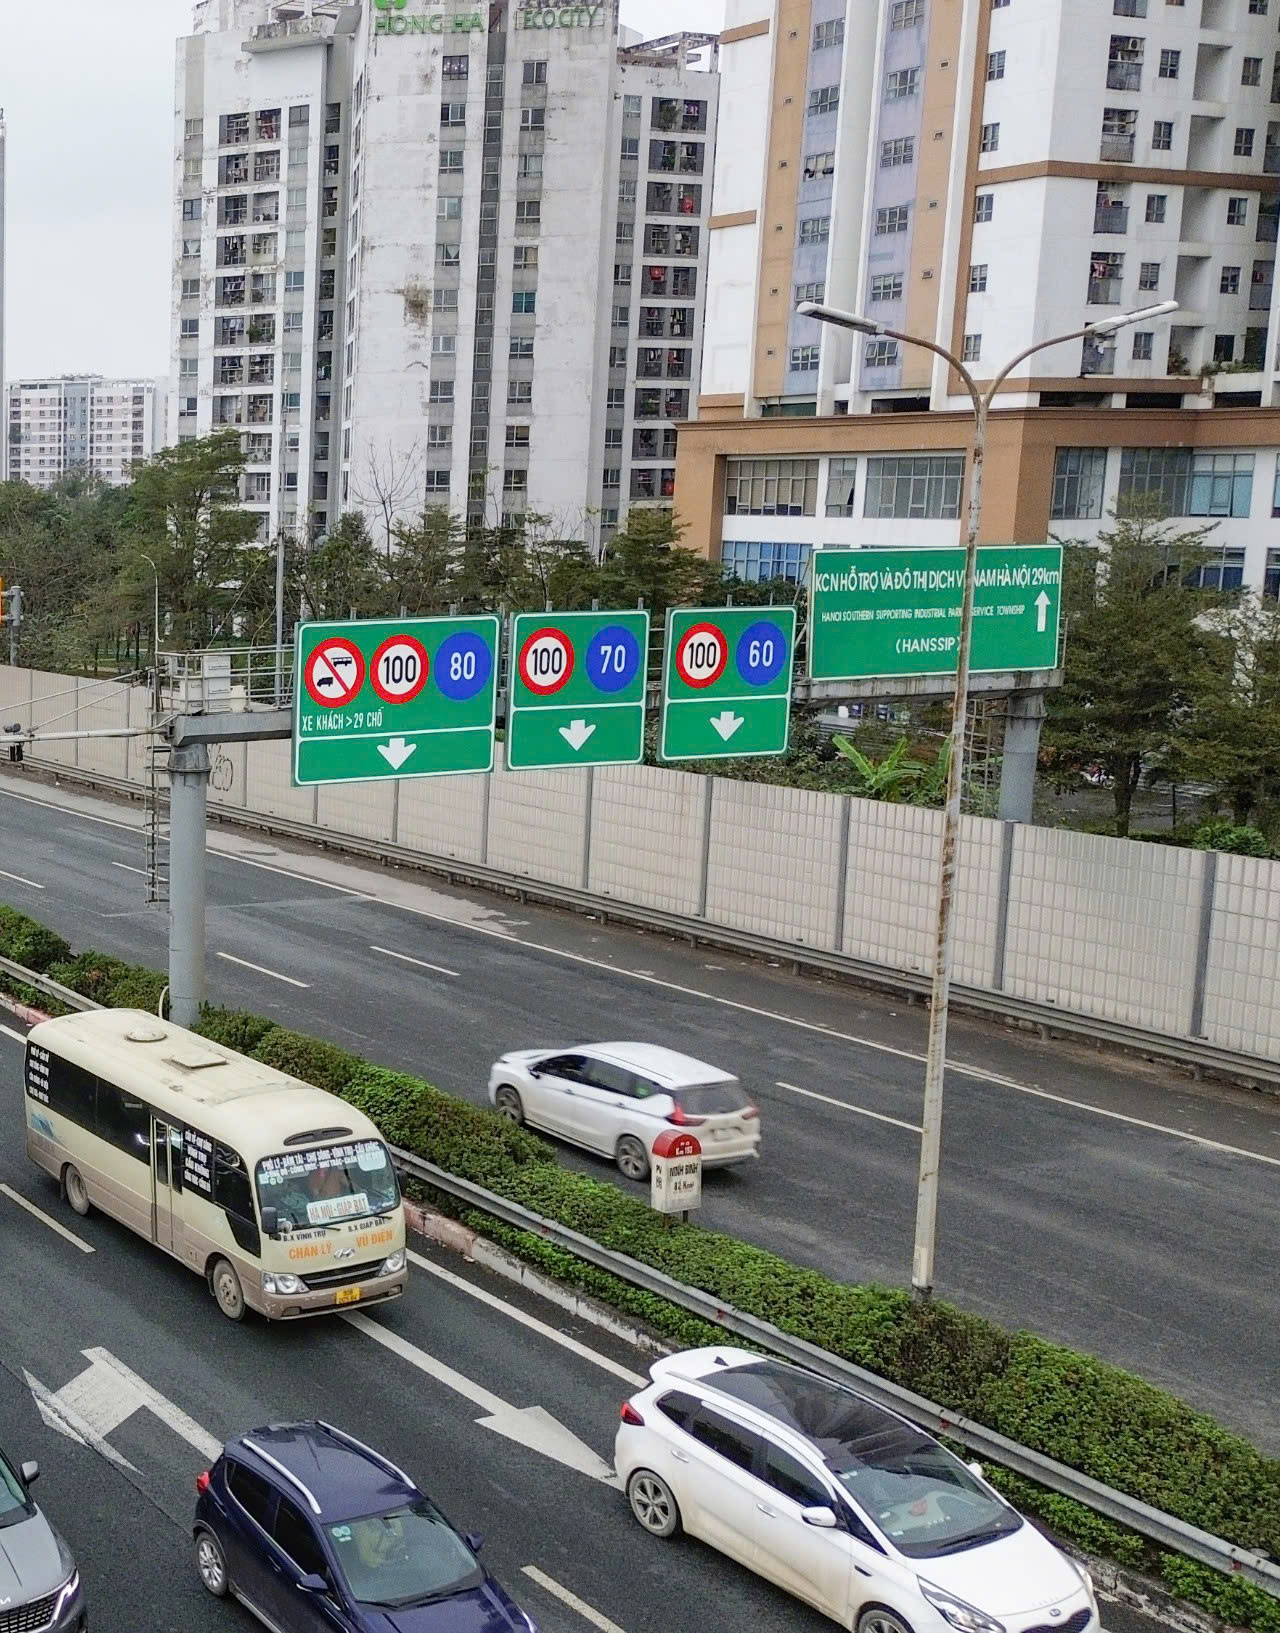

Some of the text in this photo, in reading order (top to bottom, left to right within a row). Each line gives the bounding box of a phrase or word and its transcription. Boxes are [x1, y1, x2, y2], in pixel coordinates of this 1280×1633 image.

[816, 573, 838, 592] KCN
[840, 565, 858, 592] HỖ
[858, 570, 878, 593] TRỢ
[880, 567, 893, 590] VÀ
[894, 567, 911, 590] ĐÔ
[913, 570, 928, 592] THỊ
[929, 570, 954, 592] DỊCH
[997, 563, 1011, 587] HÀ
[1012, 563, 1030, 589] NỘI
[1032, 567, 1059, 586] 29km
[822, 611, 841, 622] HANOI
[876, 608, 912, 620] SUPPORTING
[914, 608, 946, 618] INDUSTRIAL
[996, 604, 1025, 615] TOWNSHIP
[450, 650, 476, 680] 80
[531, 648, 563, 676] 100
[599, 645, 626, 674] 70
[687, 641, 718, 670] 100
[749, 639, 774, 668] 60
[383, 654, 417, 685] 100
[302, 715, 313, 732] XE
[317, 710, 344, 731] KHÁCH
[354, 712, 364, 729] 29
[367, 706, 384, 728] CHỖ
